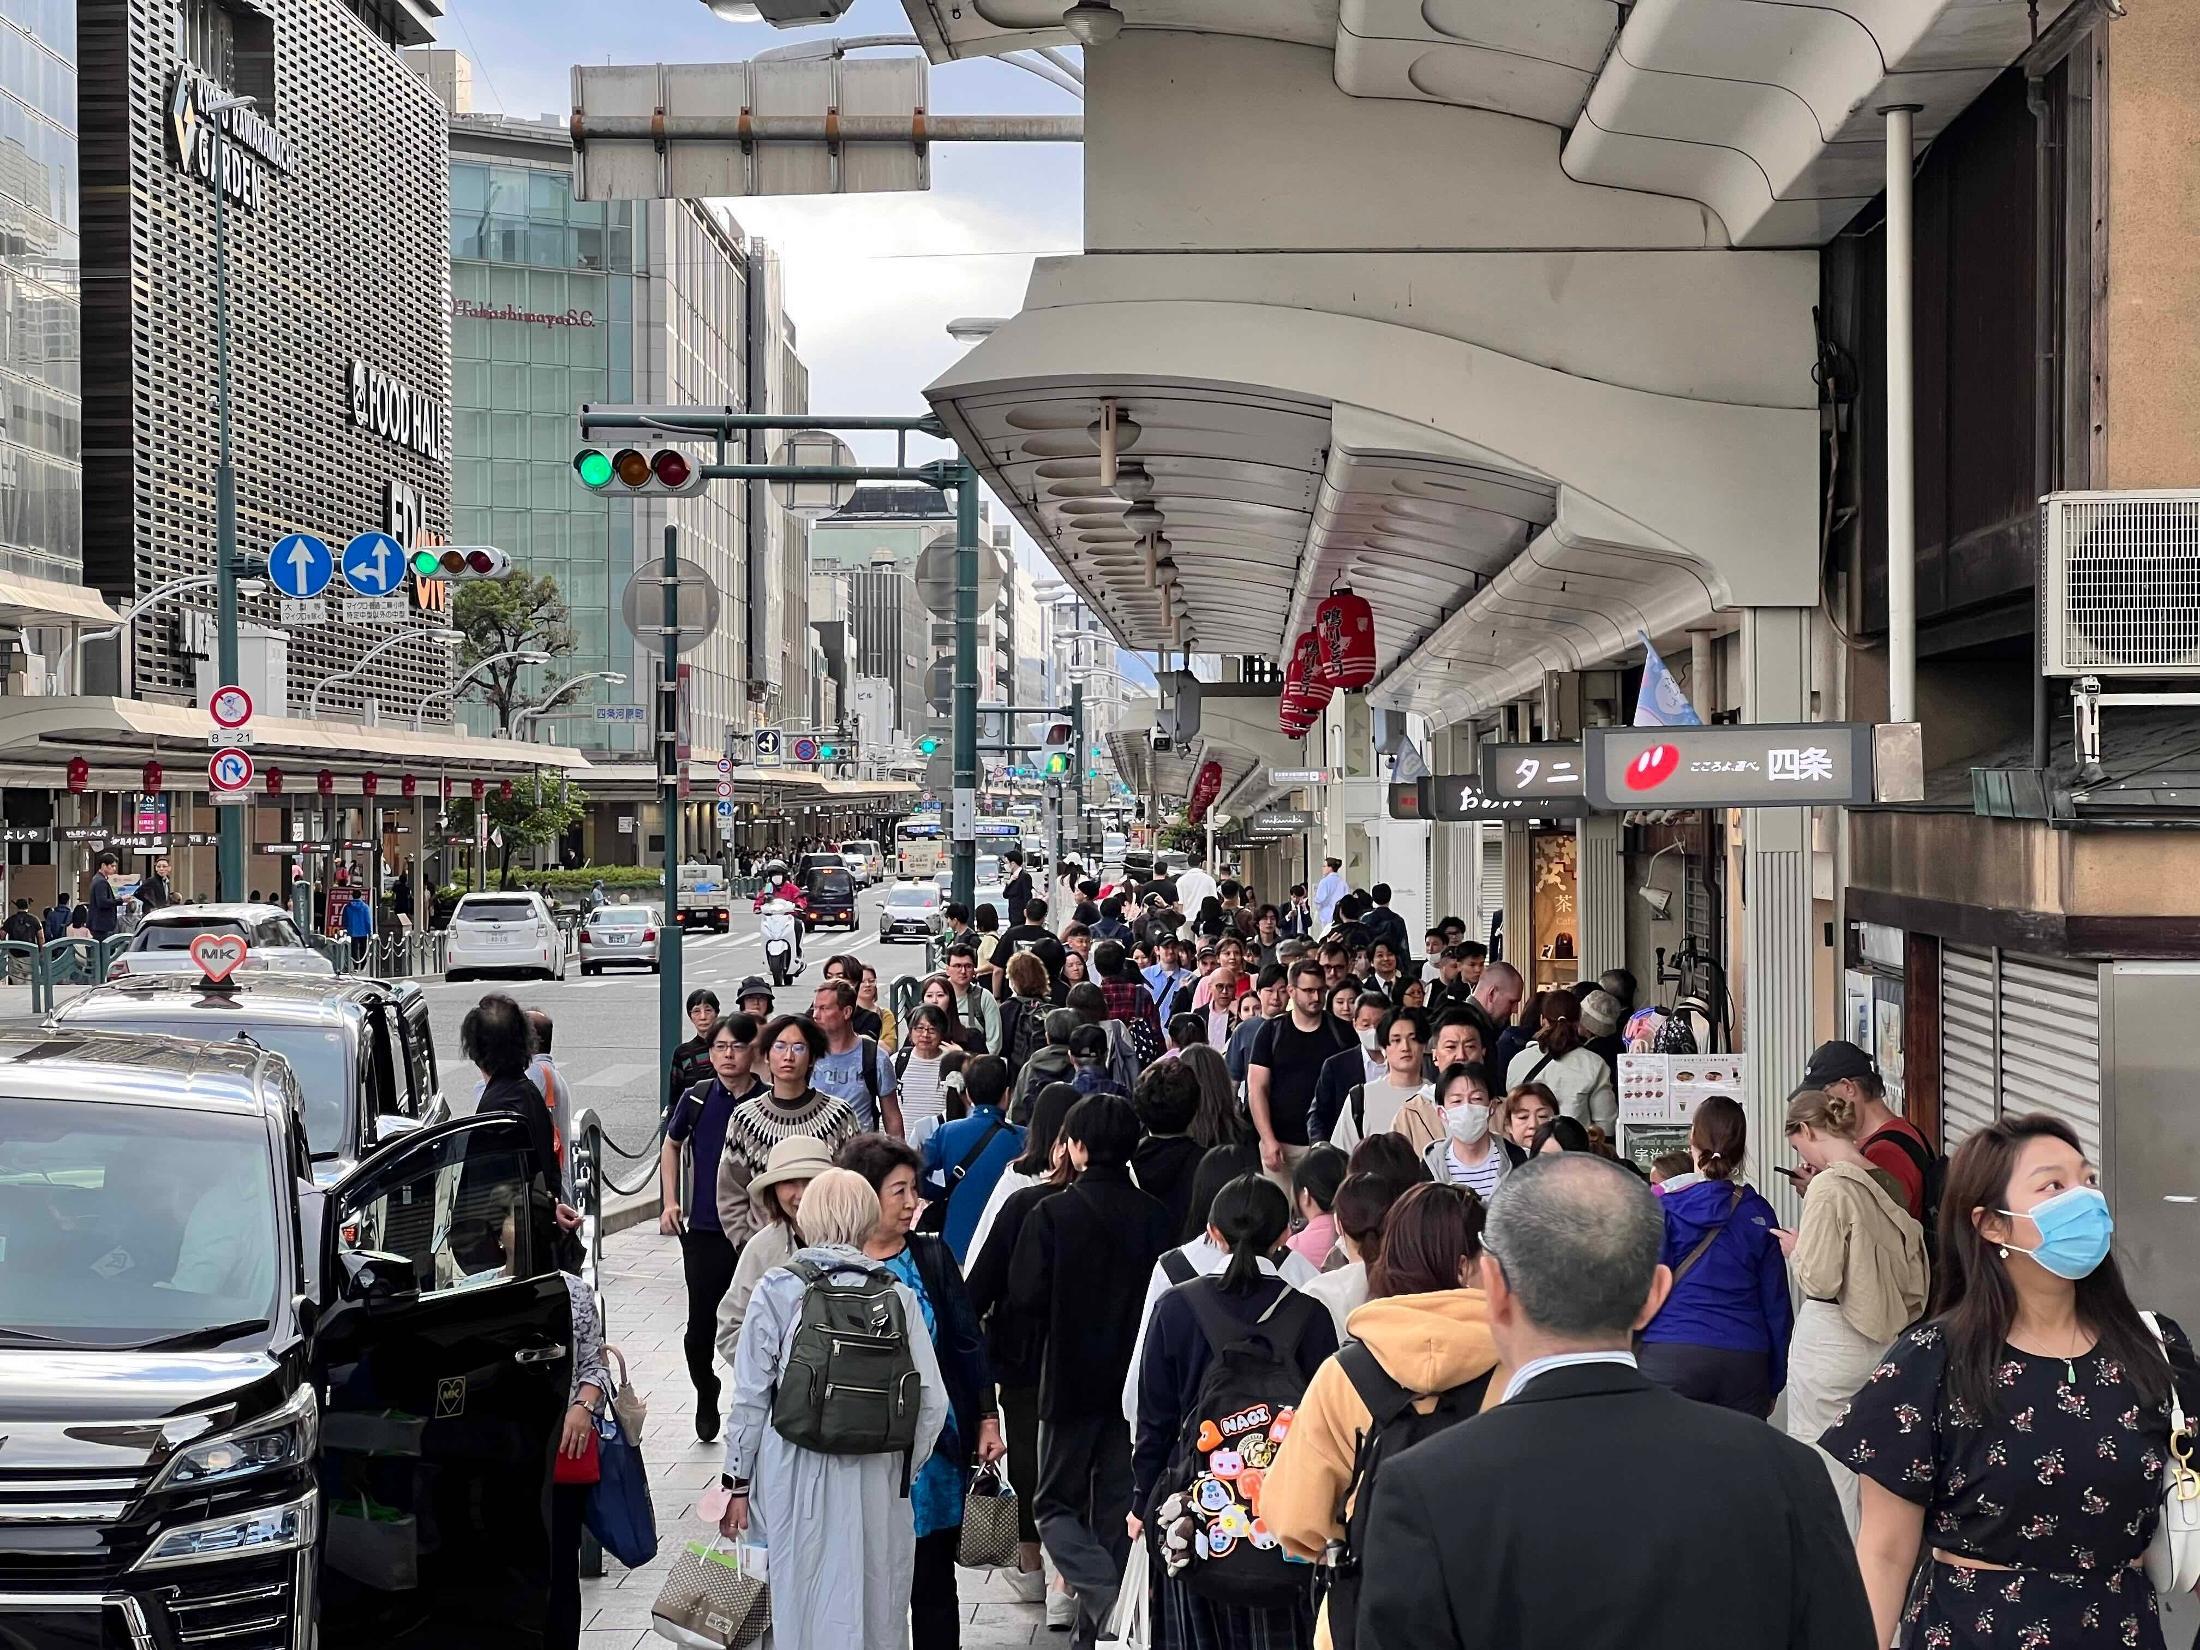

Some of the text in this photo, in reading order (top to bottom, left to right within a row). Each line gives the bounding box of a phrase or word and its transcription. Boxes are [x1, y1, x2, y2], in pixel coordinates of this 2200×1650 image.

[232, 107, 295, 176] KAWARAMACHI
[369, 367, 443, 462] FOOD HALL
[596, 708, 646, 720] 四条河原町
[1515, 758, 1579, 789] タニ
[1767, 747, 1833, 781] 四条
[3, 830, 39, 840] よしや
[1555, 894, 1573, 913] 茶
[201, 948, 236, 960] MK
[442, 1388, 460, 1400] MK
